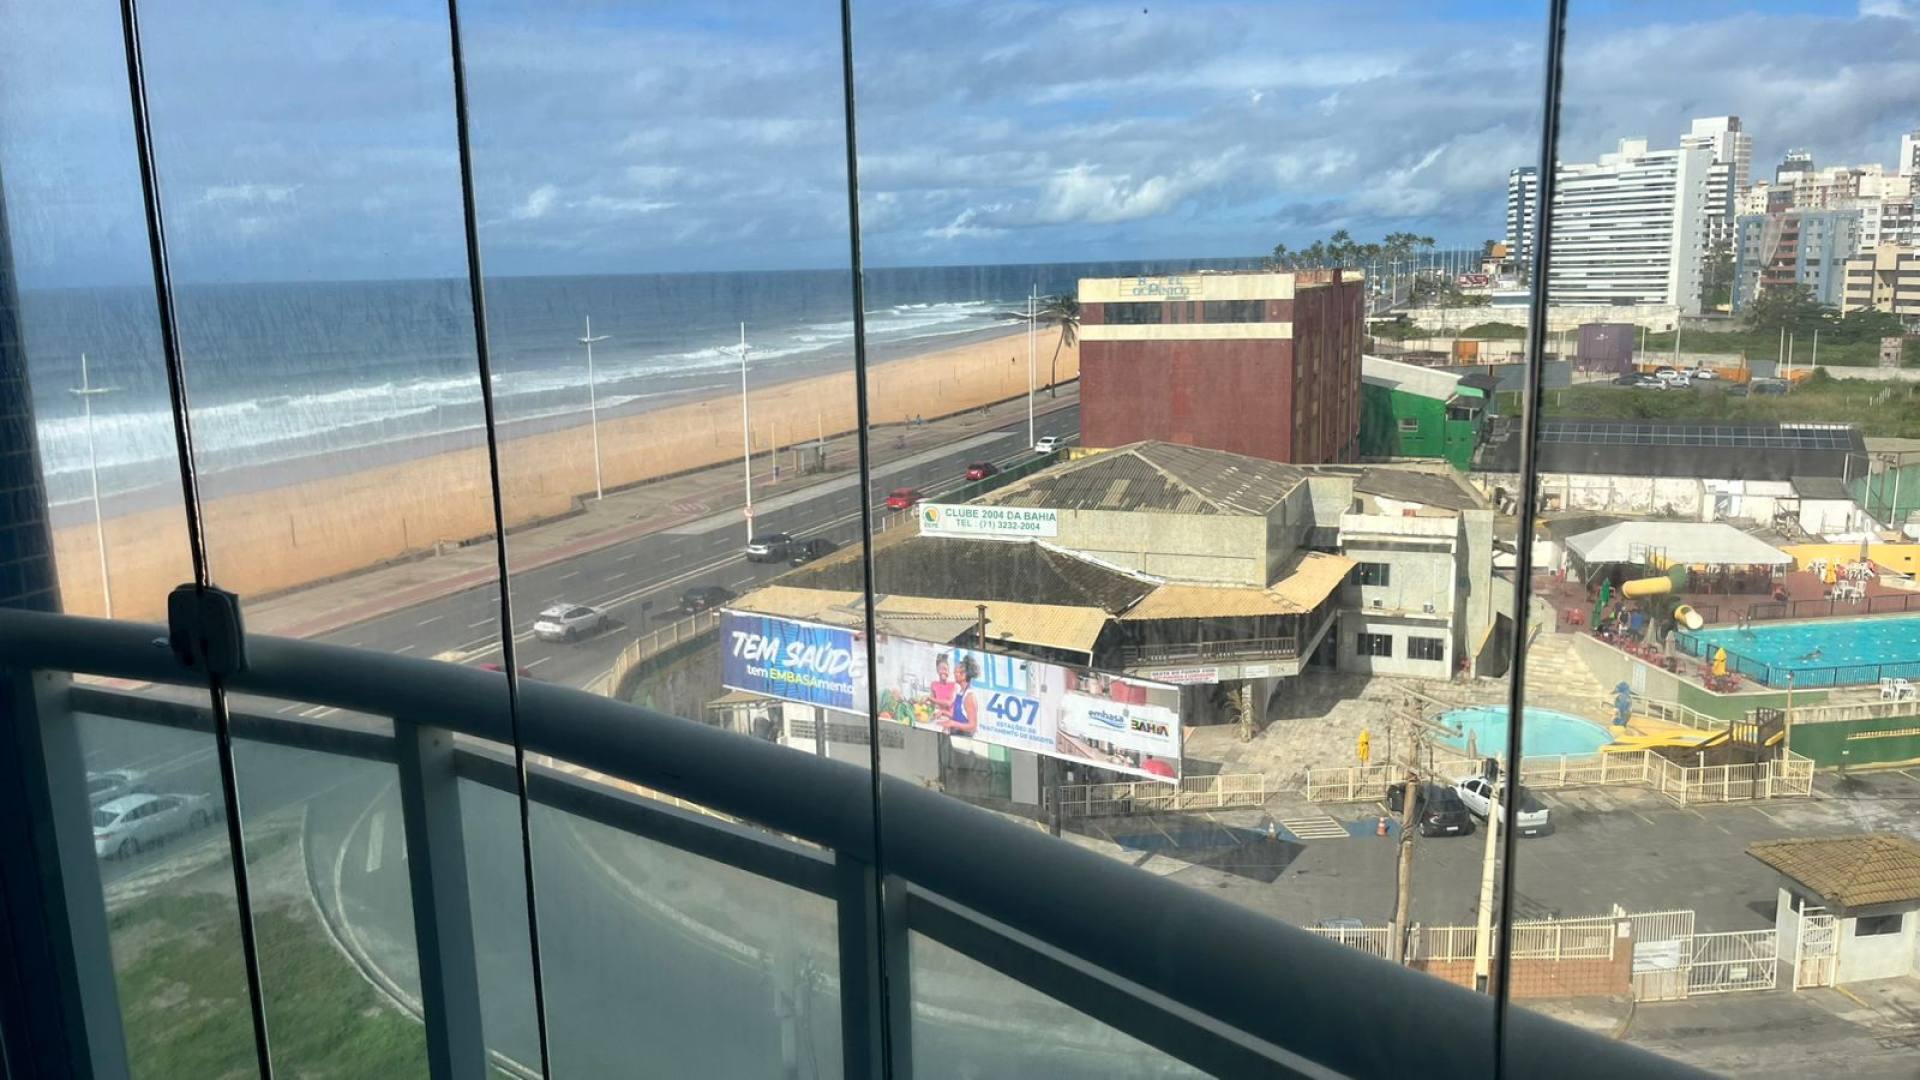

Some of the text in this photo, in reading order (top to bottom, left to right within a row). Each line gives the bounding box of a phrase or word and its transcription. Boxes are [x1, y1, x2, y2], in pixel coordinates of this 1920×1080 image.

[945, 508, 1057, 522] CLUBE 2004 DA BAHIA
[998, 521, 1040, 531] 3232-2004
[732, 631, 866, 678] TEM SAÚDE
[746, 663, 769, 678] tem
[986, 693, 1040, 725] 407
[1088, 709, 1124, 723] embasa
[1130, 719, 1170, 737] BAHIA
